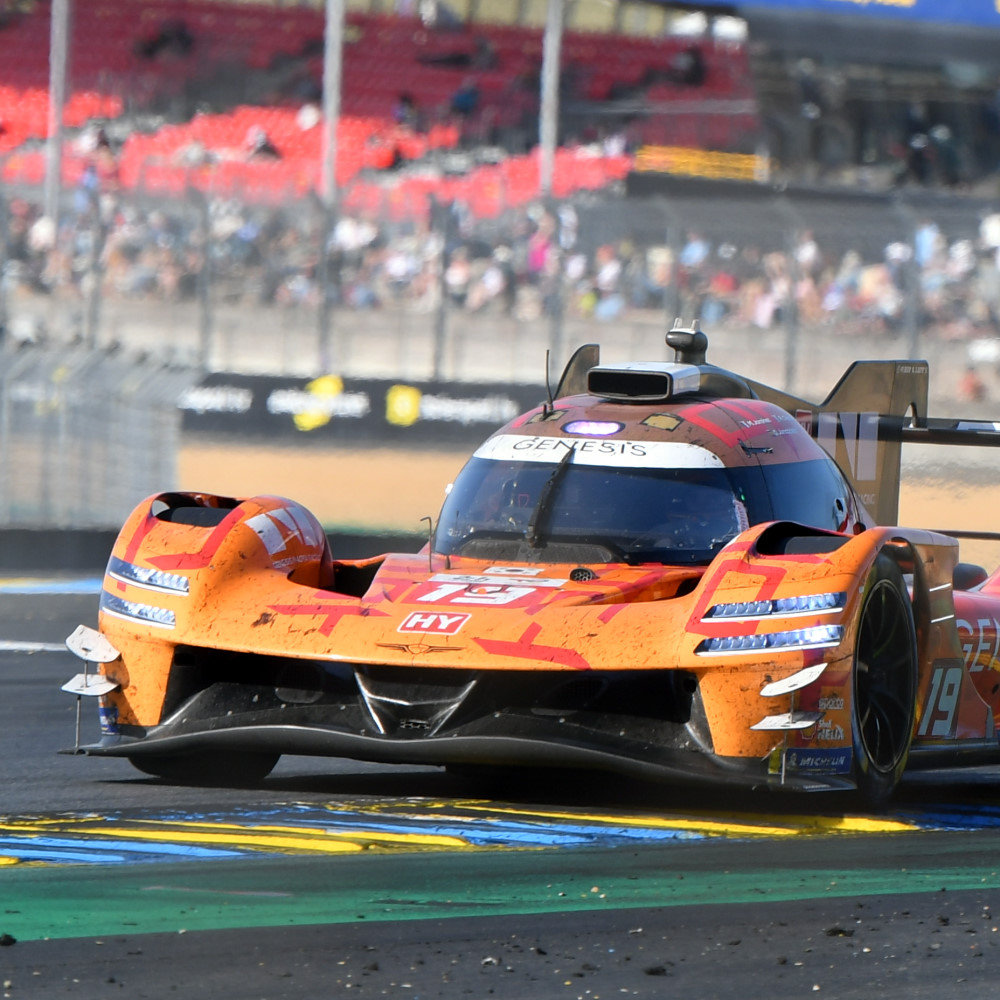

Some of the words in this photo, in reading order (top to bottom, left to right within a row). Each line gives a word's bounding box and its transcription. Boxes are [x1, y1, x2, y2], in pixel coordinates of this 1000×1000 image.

[512, 438, 647, 457] GENESIS
[415, 583, 537, 605] 19
[405, 614, 464, 630] HY
[917, 667, 963, 736] 19
